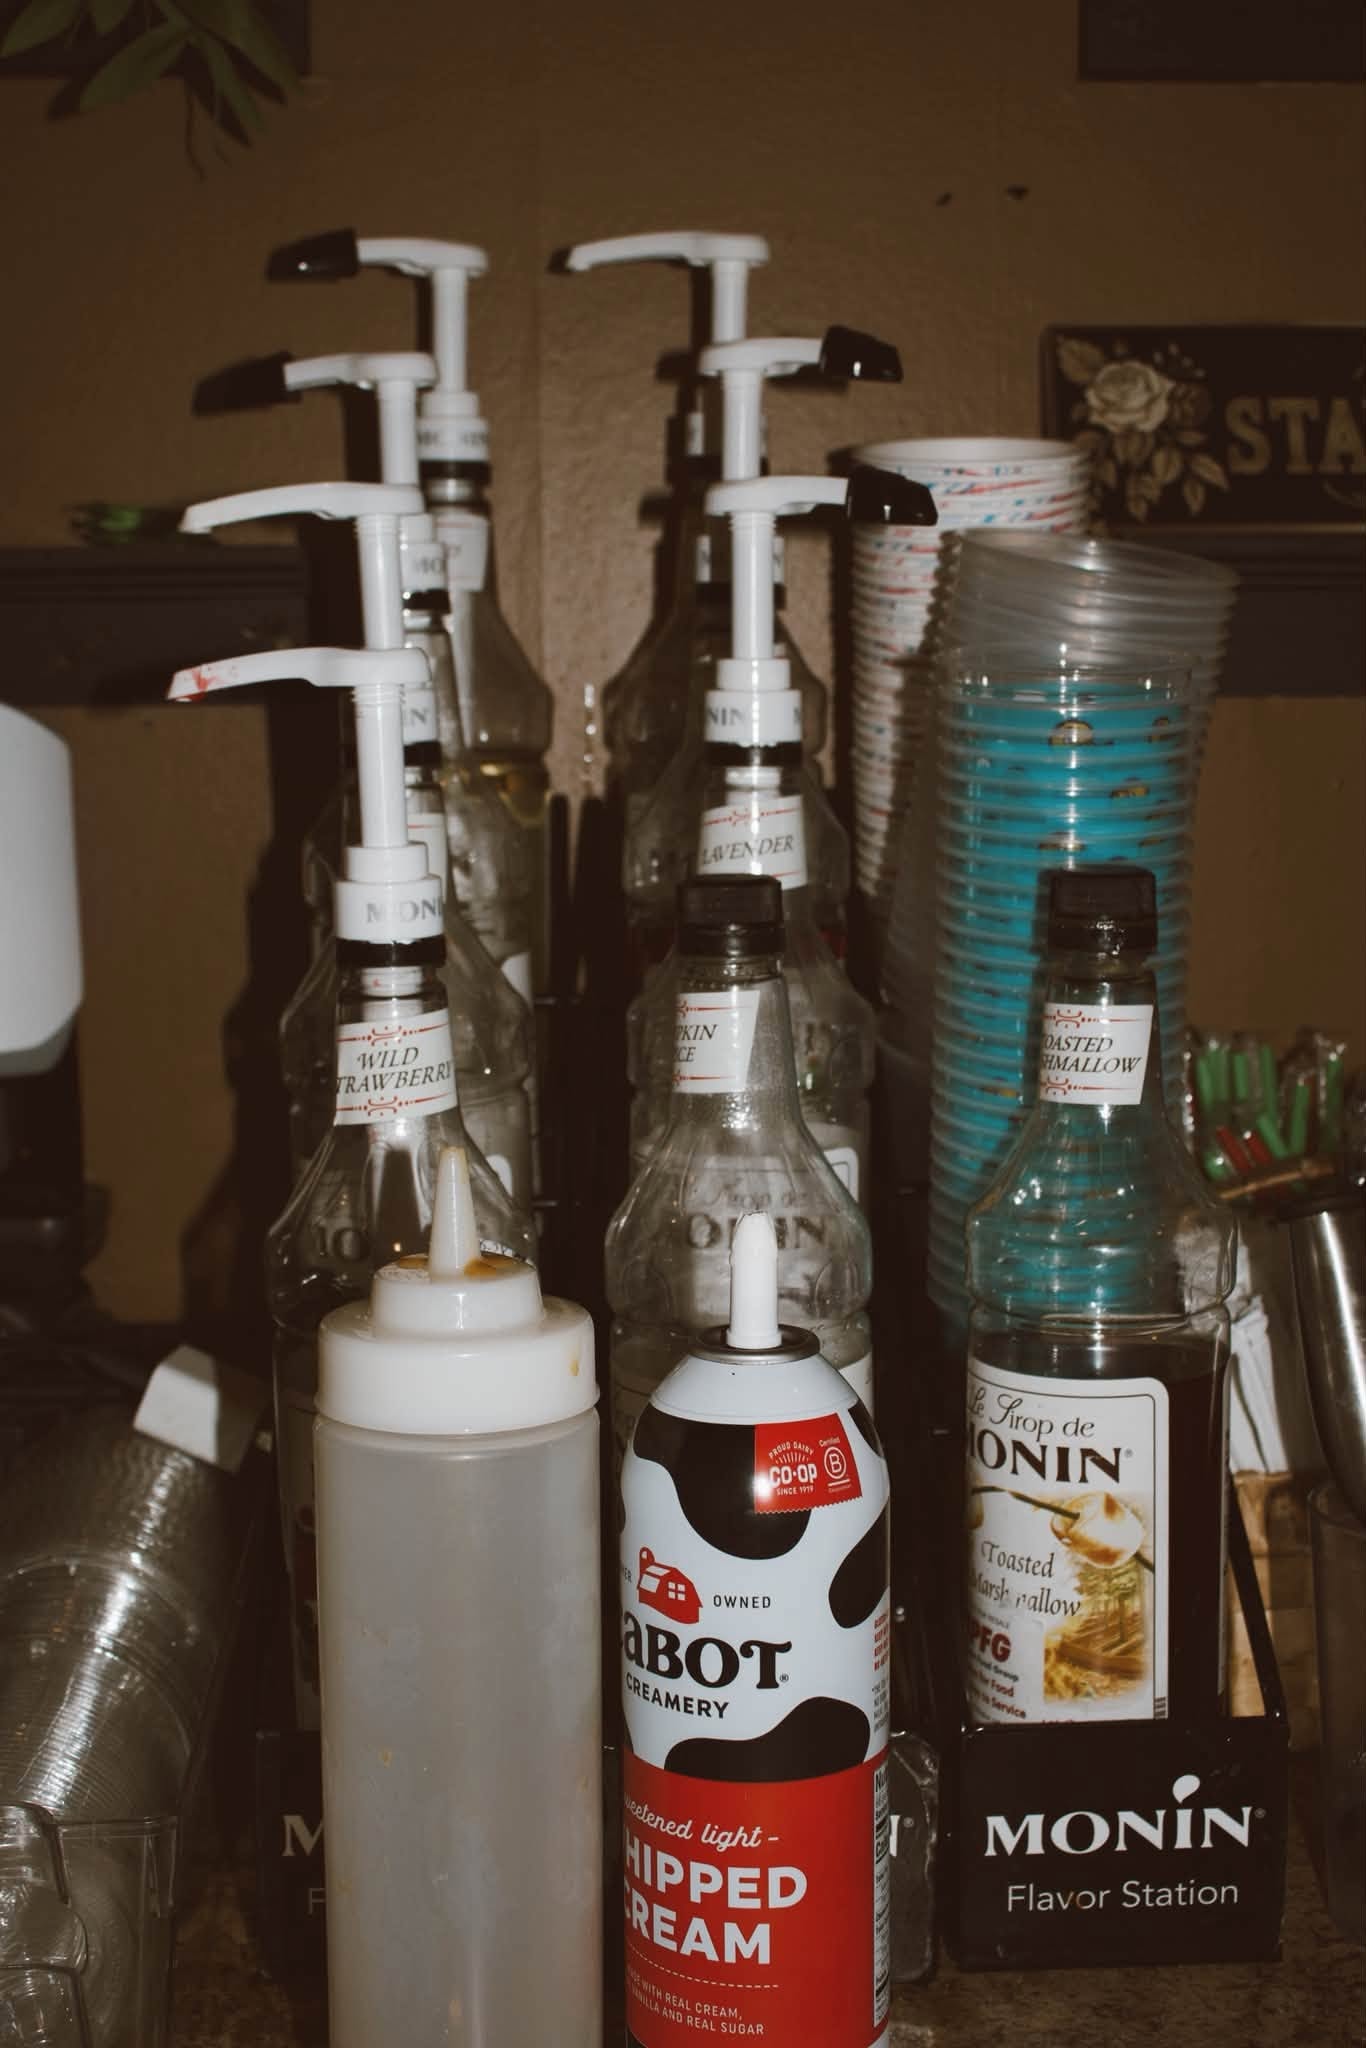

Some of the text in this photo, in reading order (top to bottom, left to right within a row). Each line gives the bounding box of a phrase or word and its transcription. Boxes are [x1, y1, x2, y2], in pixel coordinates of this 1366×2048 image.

[703, 835, 794, 865] LAVENDER
[357, 1047, 419, 1070] WILD
[989, 1393, 1053, 1442] Sirop
[1063, 1418, 1095, 1438] de
[768, 1441, 815, 1459] PROUD DAIRY
[776, 1486, 797, 1496] SINCE
[981, 1541, 1055, 1578] Toasted
[713, 1595, 772, 1609] OWNED
[626, 1671, 729, 1719] CREAMERY
[991, 1695, 1026, 1719] Service
[984, 1774, 1253, 1857] MONIN
[700, 1823, 763, 1852] light
[1007, 1879, 1239, 1912] Flavor Station
[642, 1980, 662, 2000] WITH
[665, 1992, 691, 2011] REAL
[695, 2003, 743, 2021] CREAM,
[662, 2007, 683, 2024] AND
[686, 2015, 716, 2032] REAL
[720, 2022, 765, 2036] SUGAR
